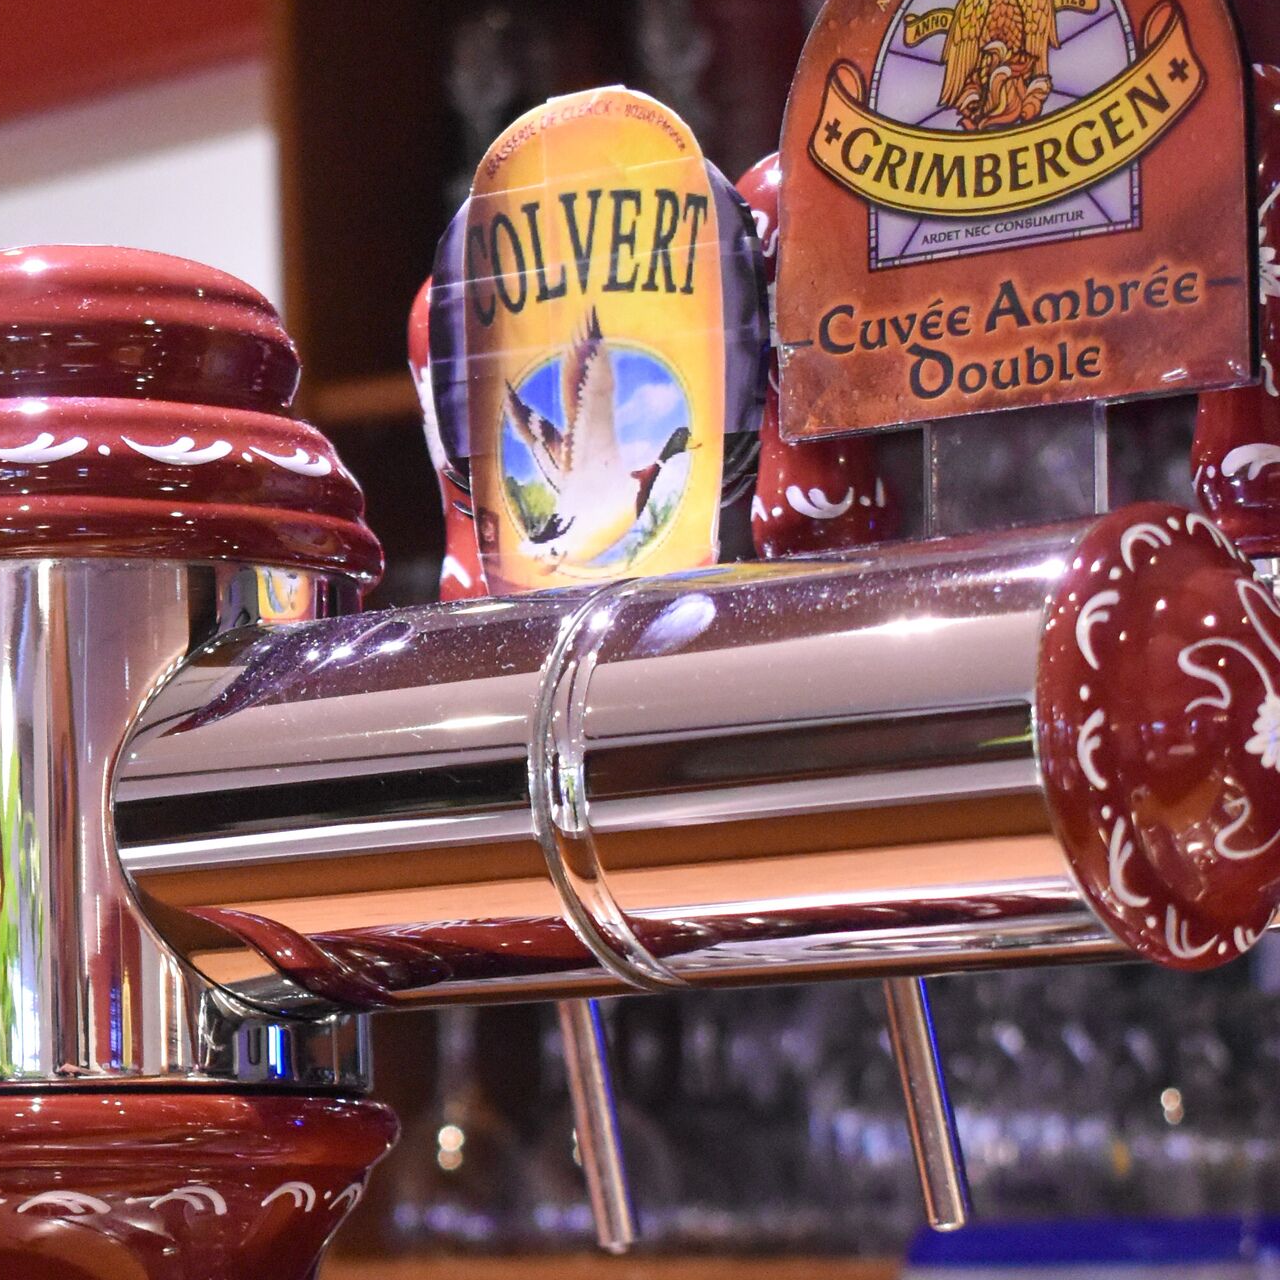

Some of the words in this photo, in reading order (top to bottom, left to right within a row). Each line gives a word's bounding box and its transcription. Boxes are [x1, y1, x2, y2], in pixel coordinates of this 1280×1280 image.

[913, 14, 949, 40] ANNO
[840, 73, 1174, 200] GRIMBERGEN
[468, 187, 709, 329] COLVERT
[921, 231, 961, 246] ARDET
[965, 226, 991, 239] NEC
[994, 209, 1085, 235] CONSUMITUR
[819, 297, 972, 356] Cuvée
[984, 265, 1200, 334] Ambrée
[907, 343, 1102, 401] Double
